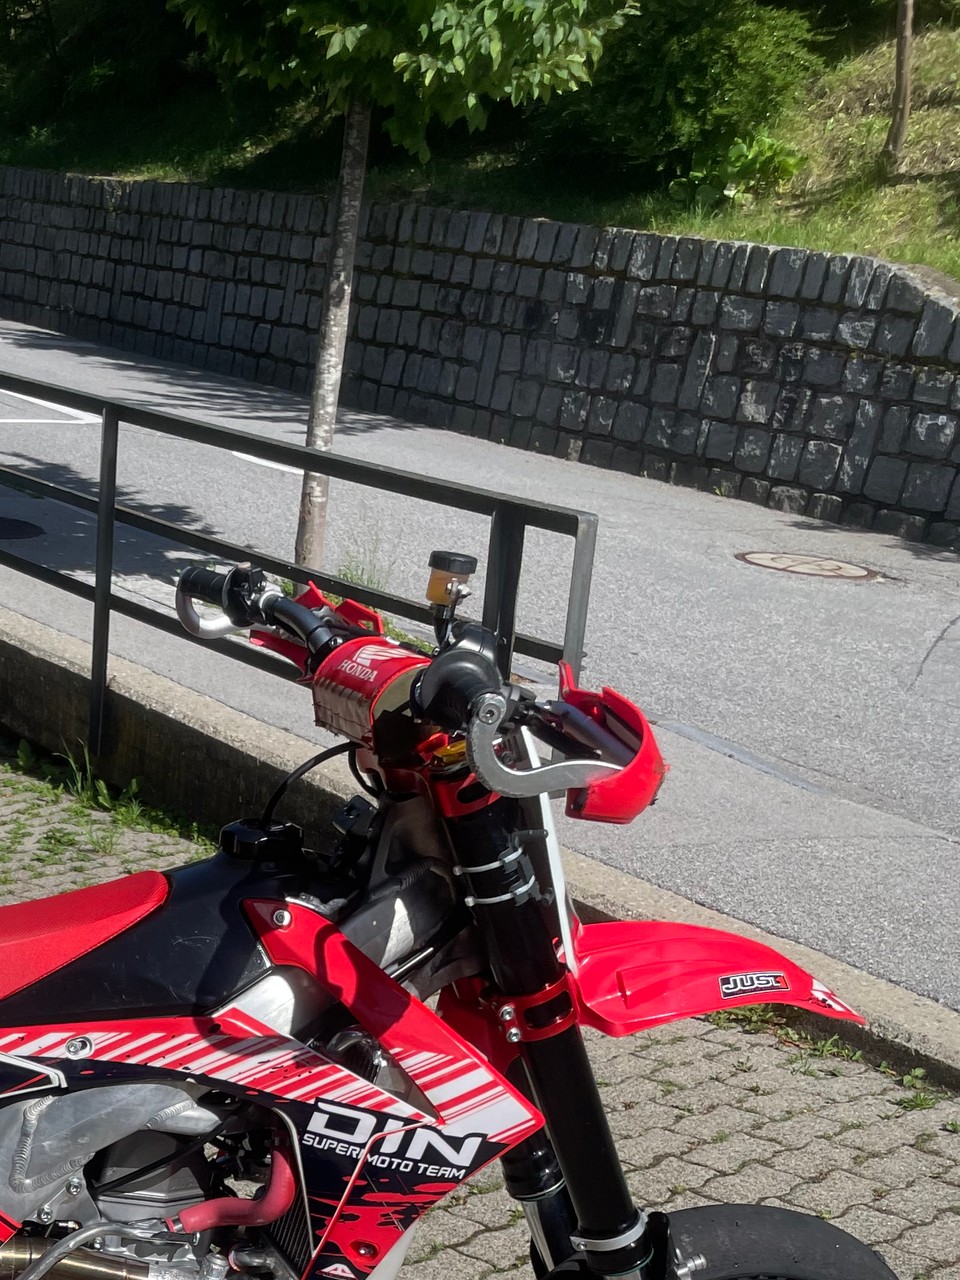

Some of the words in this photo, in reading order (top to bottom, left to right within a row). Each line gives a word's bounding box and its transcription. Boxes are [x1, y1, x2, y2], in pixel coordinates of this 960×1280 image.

[337, 659, 378, 682] HONDA
[302, 1132, 413, 1173] SUPERMOTO
[417, 1162, 466, 1180] TEAM
[306, 1101, 483, 1167] DIN
